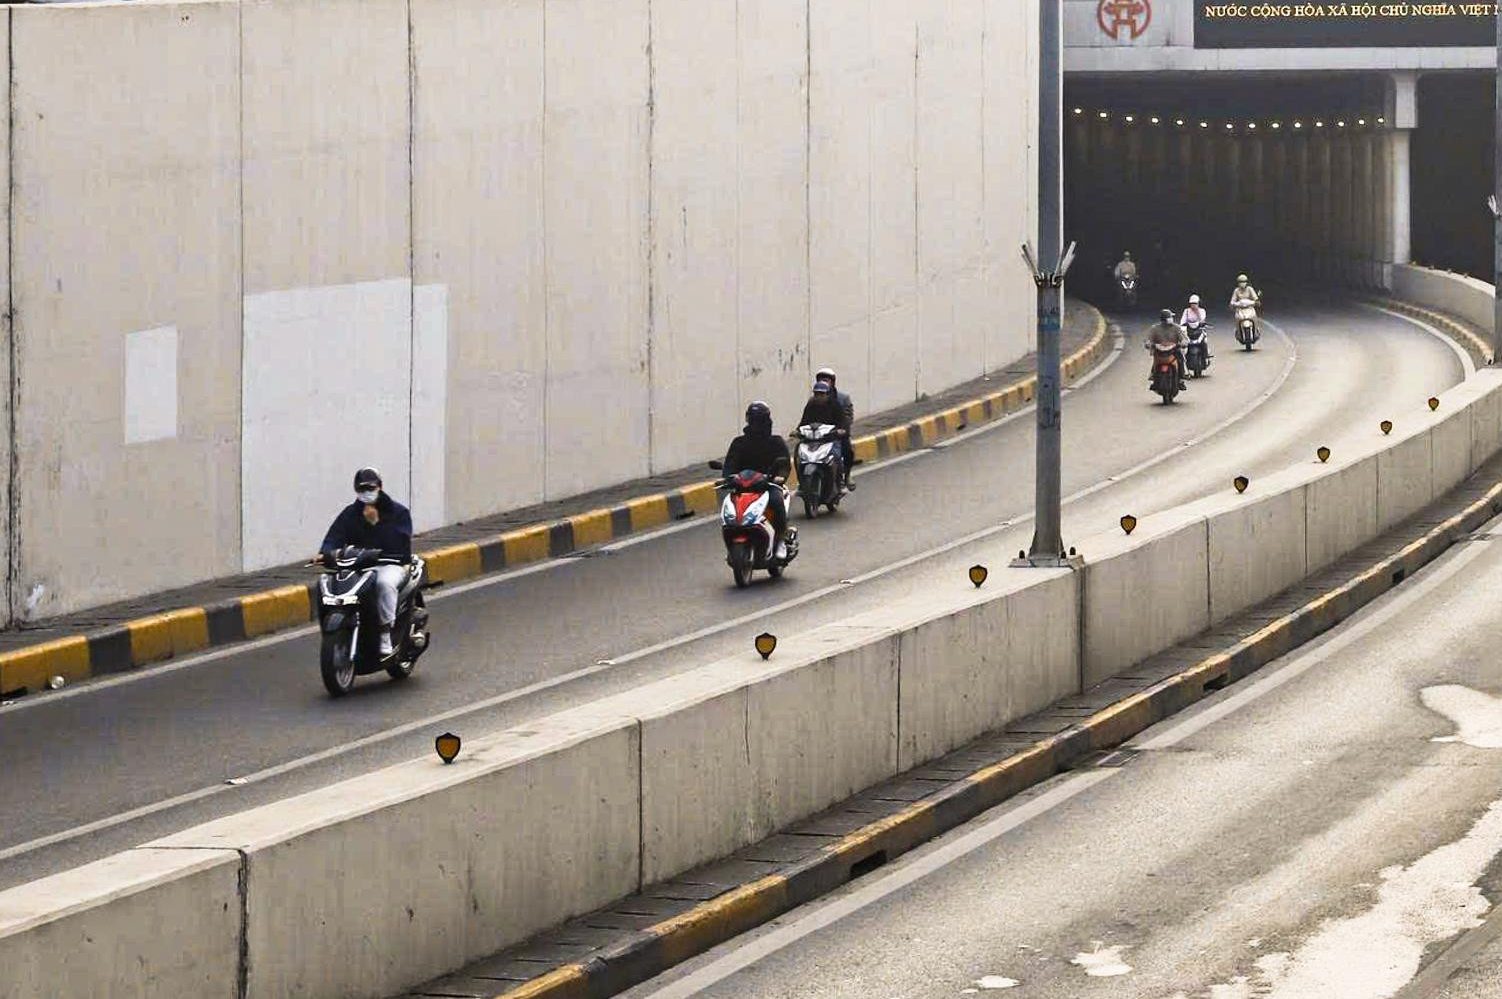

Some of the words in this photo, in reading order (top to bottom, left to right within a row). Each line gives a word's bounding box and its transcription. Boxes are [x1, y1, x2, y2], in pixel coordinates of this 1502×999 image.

[1205, 3, 1248, 17] NƯỚC
[1250, 2, 1291, 18] CỘNG
[1293, 2, 1325, 17] HÒA
[1327, 2, 1349, 17] XÃ
[1350, 1, 1377, 18] HỘI
[1379, 1, 1409, 17] CHỦ
[1411, 1, 1456, 16] NGHĨA
[1459, 2, 1493, 17] VIỆT
